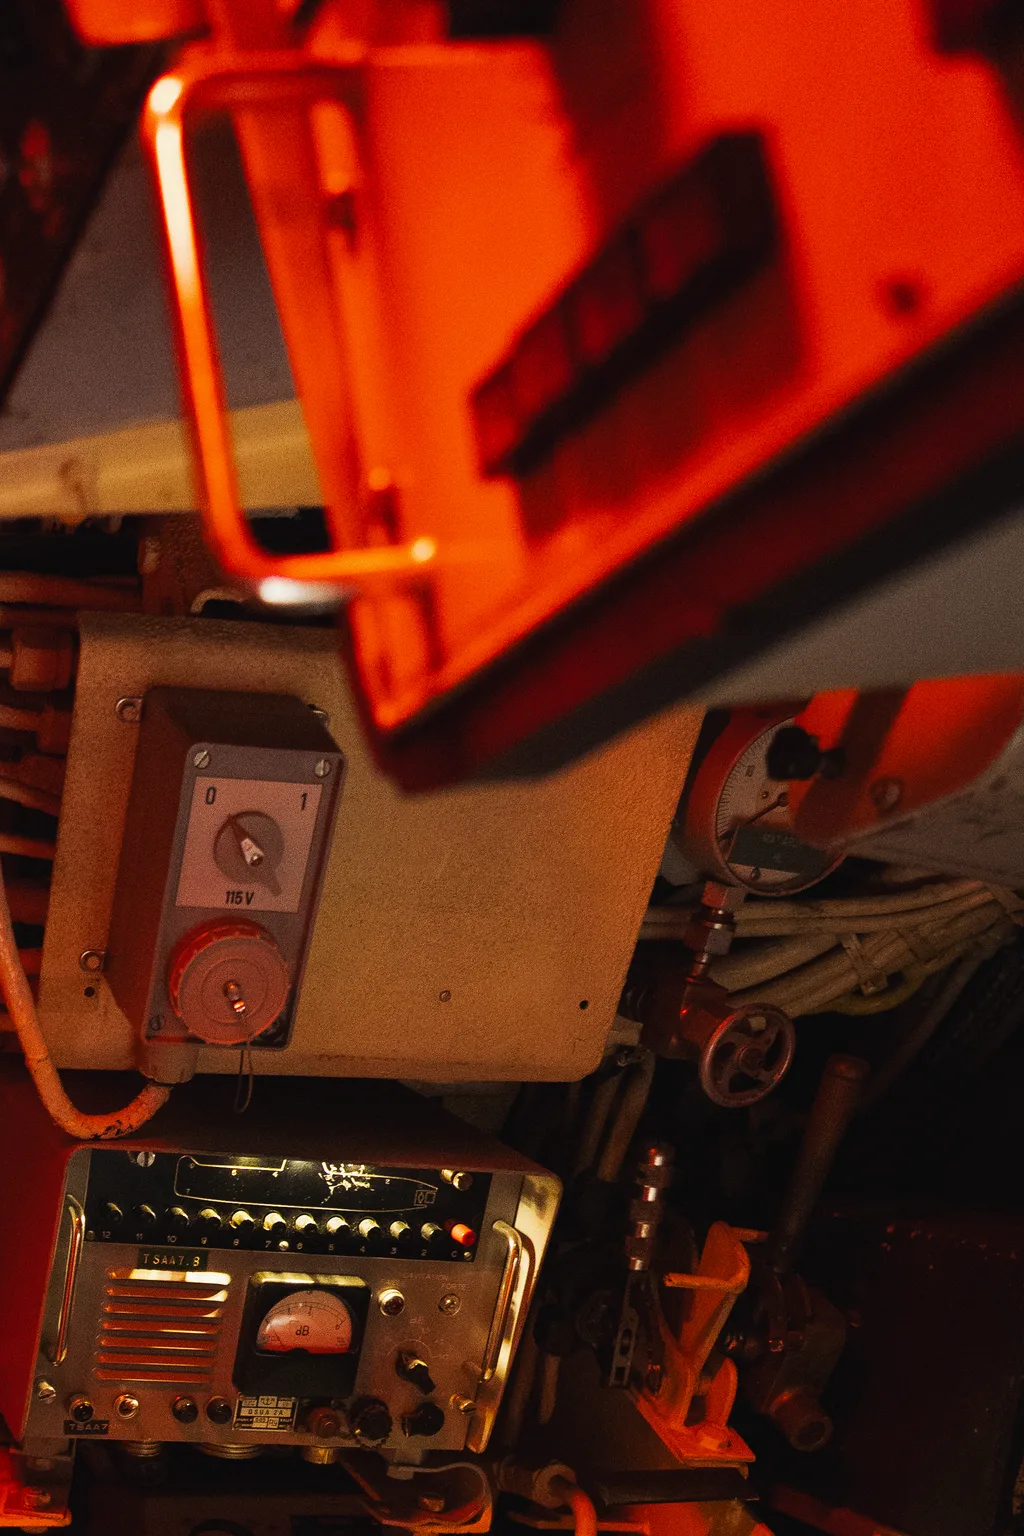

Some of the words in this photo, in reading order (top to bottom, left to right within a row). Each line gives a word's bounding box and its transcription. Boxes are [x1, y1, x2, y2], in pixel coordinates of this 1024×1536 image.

[205, 786, 216, 805] 0
[300, 793, 308, 811] 1
[226, 890, 242, 905] 115
[245, 892, 254, 905] V
[102, 1230, 111, 1239] 12
[136, 1233, 144, 1241] 11
[166, 1235, 177, 1243] 10
[200, 1236, 207, 1245] 9
[265, 1240, 272, 1249] 7
[359, 1245, 366, 1253] 4
[390, 1247, 397, 1255] 3
[420, 1249, 427, 1257] 2
[295, 1325, 310, 1336] dB
